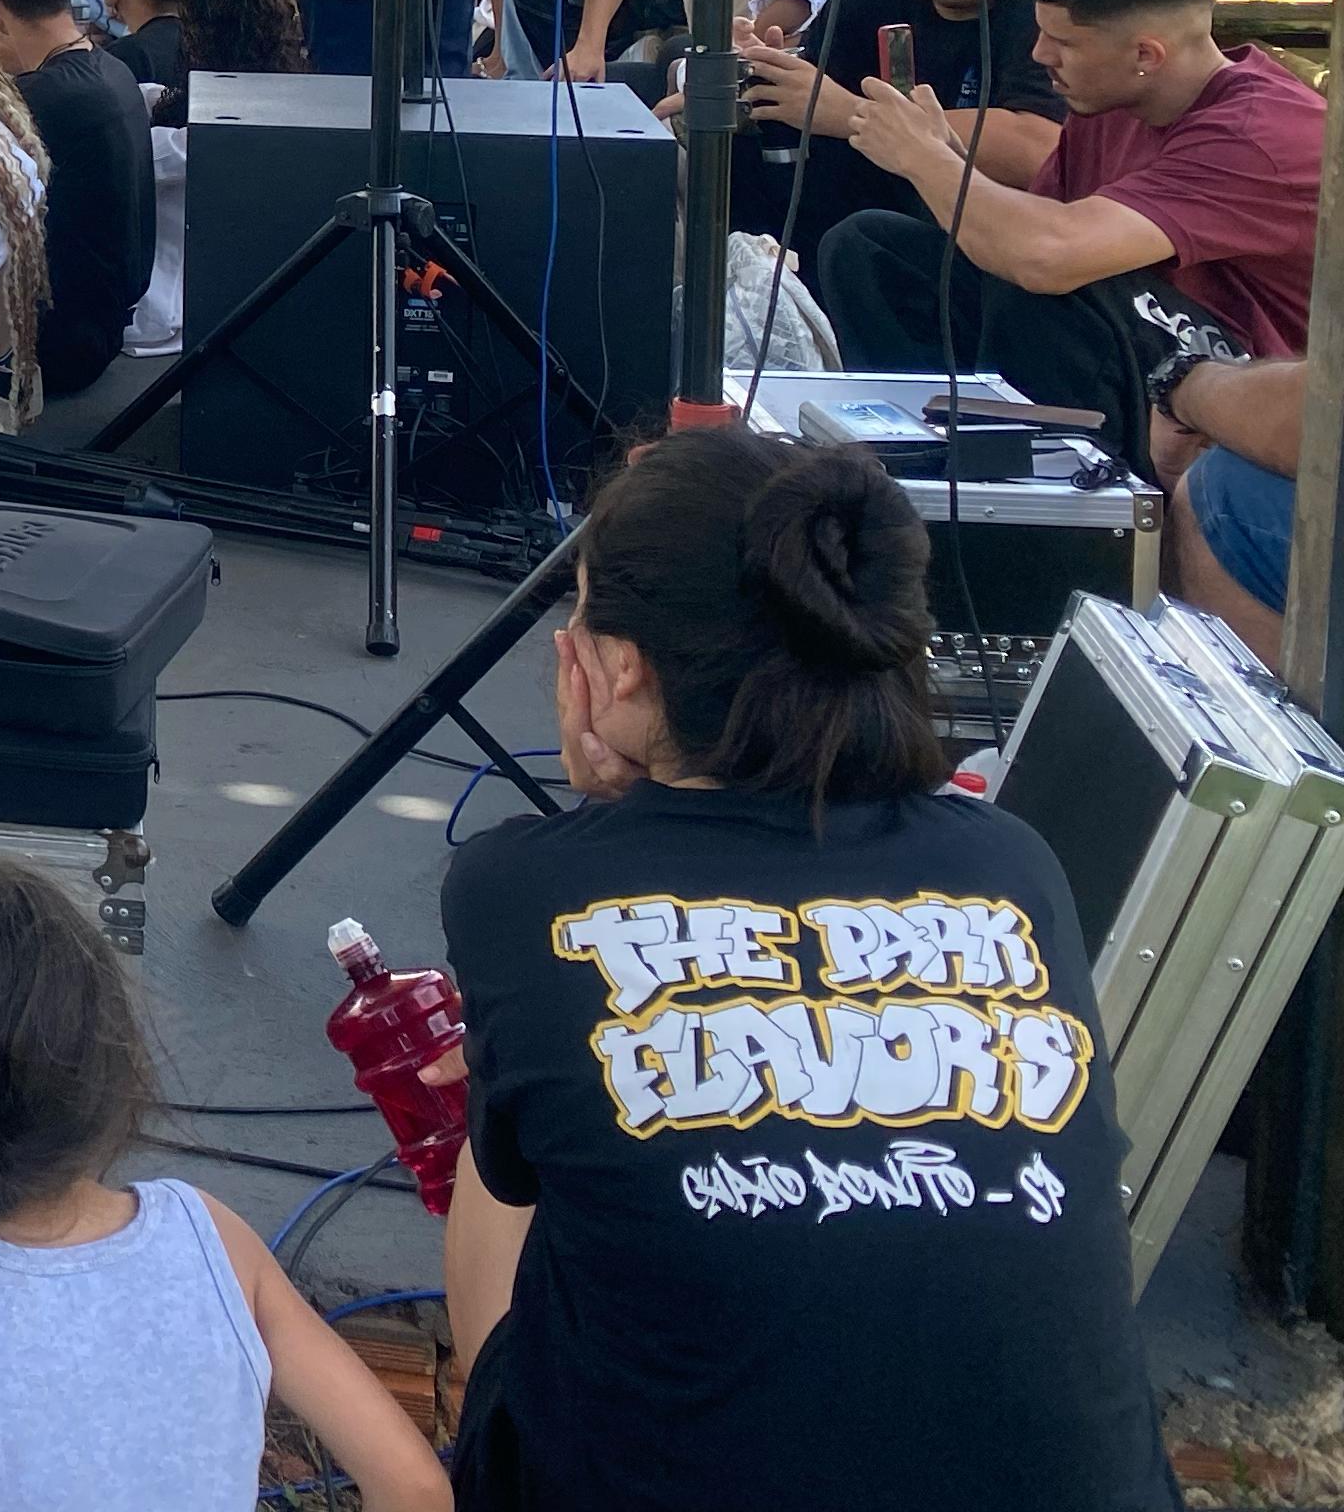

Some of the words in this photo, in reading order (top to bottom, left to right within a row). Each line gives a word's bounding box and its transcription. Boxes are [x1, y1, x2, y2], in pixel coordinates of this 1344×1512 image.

[555, 896, 800, 1016] THE
[800, 893, 1049, 1001] PARK
[591, 997, 1094, 1139] FLAVOR'S
[682, 1152, 806, 1220] CAPÃO
[806, 1141, 975, 1224] BONITO
[1019, 1152, 1066, 1224] SP
